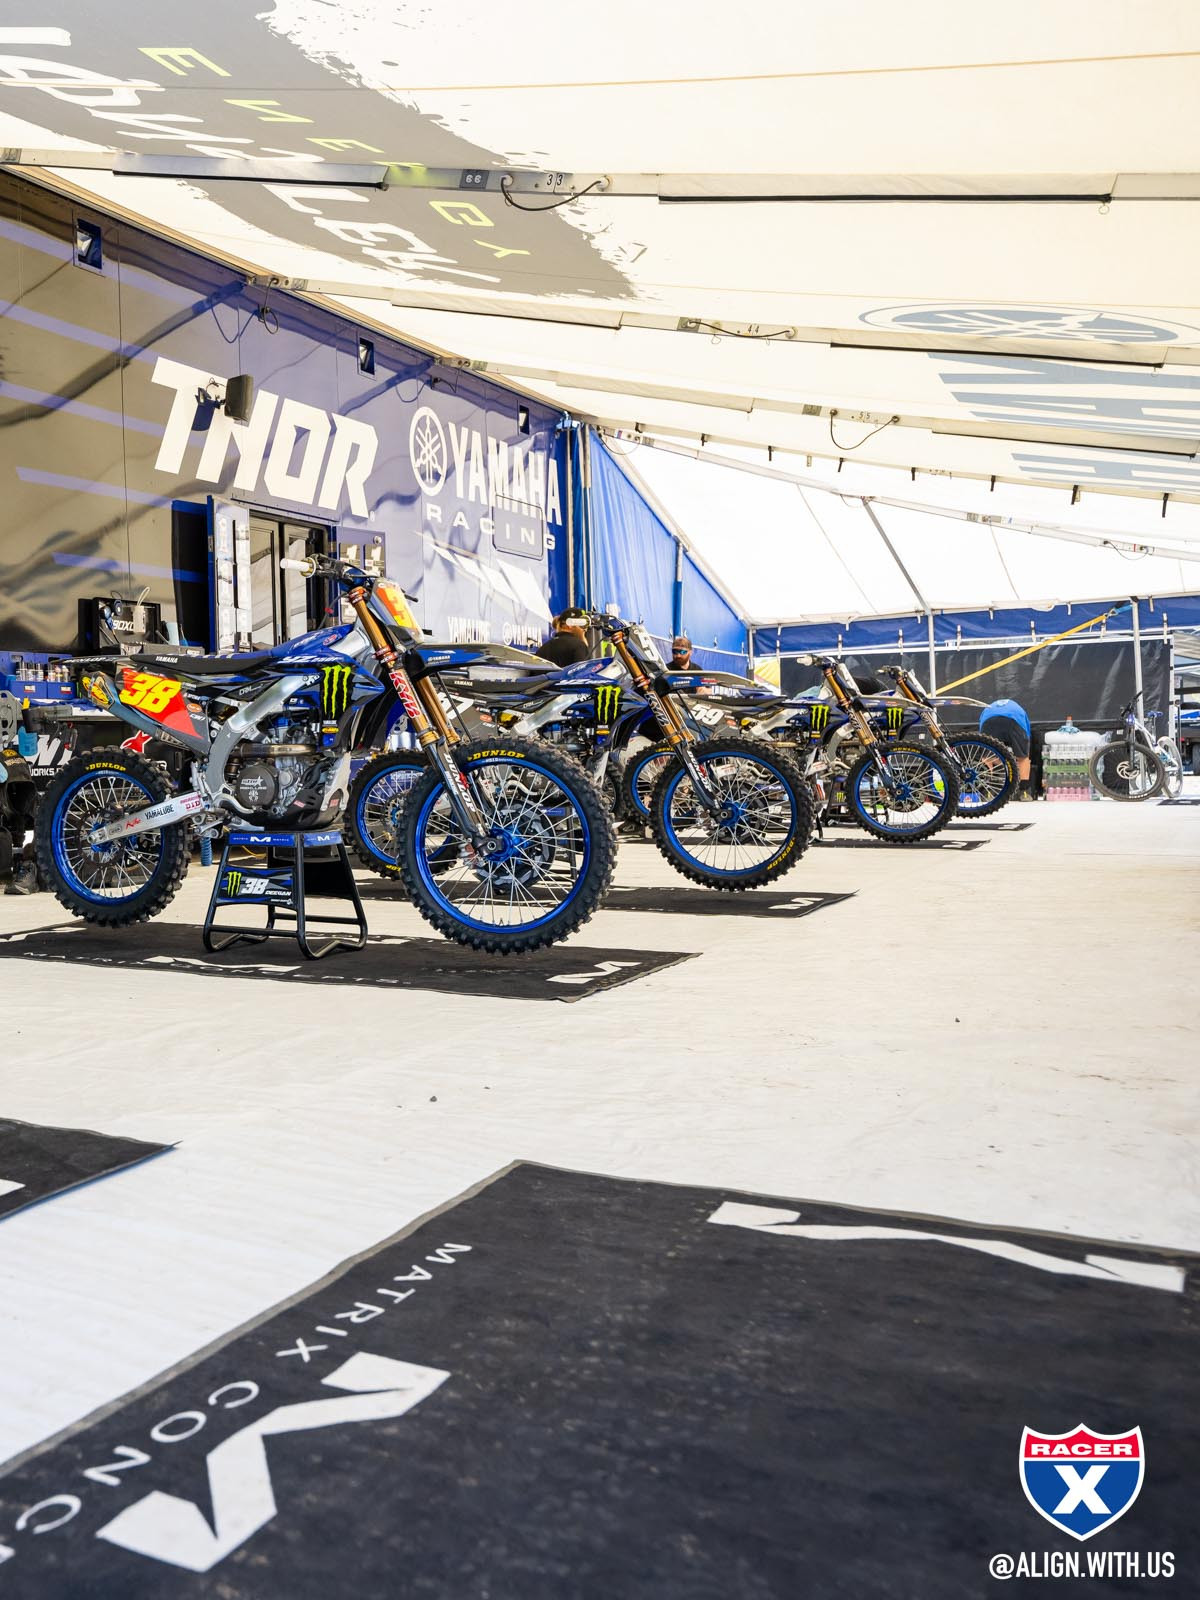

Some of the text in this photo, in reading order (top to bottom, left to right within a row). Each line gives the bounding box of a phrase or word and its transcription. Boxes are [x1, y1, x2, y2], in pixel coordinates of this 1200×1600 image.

[151, 356, 379, 519] THOR
[448, 421, 563, 526] YAMAHA
[426, 503, 556, 551] RACING
[155, 655, 178, 664] YAMAHA
[118, 673, 183, 714] 38
[89, 762, 127, 772] DUNLOP
[473, 750, 526, 761] DUNLOP
[443, 752, 477, 813] DUNLOP
[144, 804, 175, 821] YAMALUBE
[241, 878, 270, 895] 38
[276, 1242, 474, 1363] MATRIX
